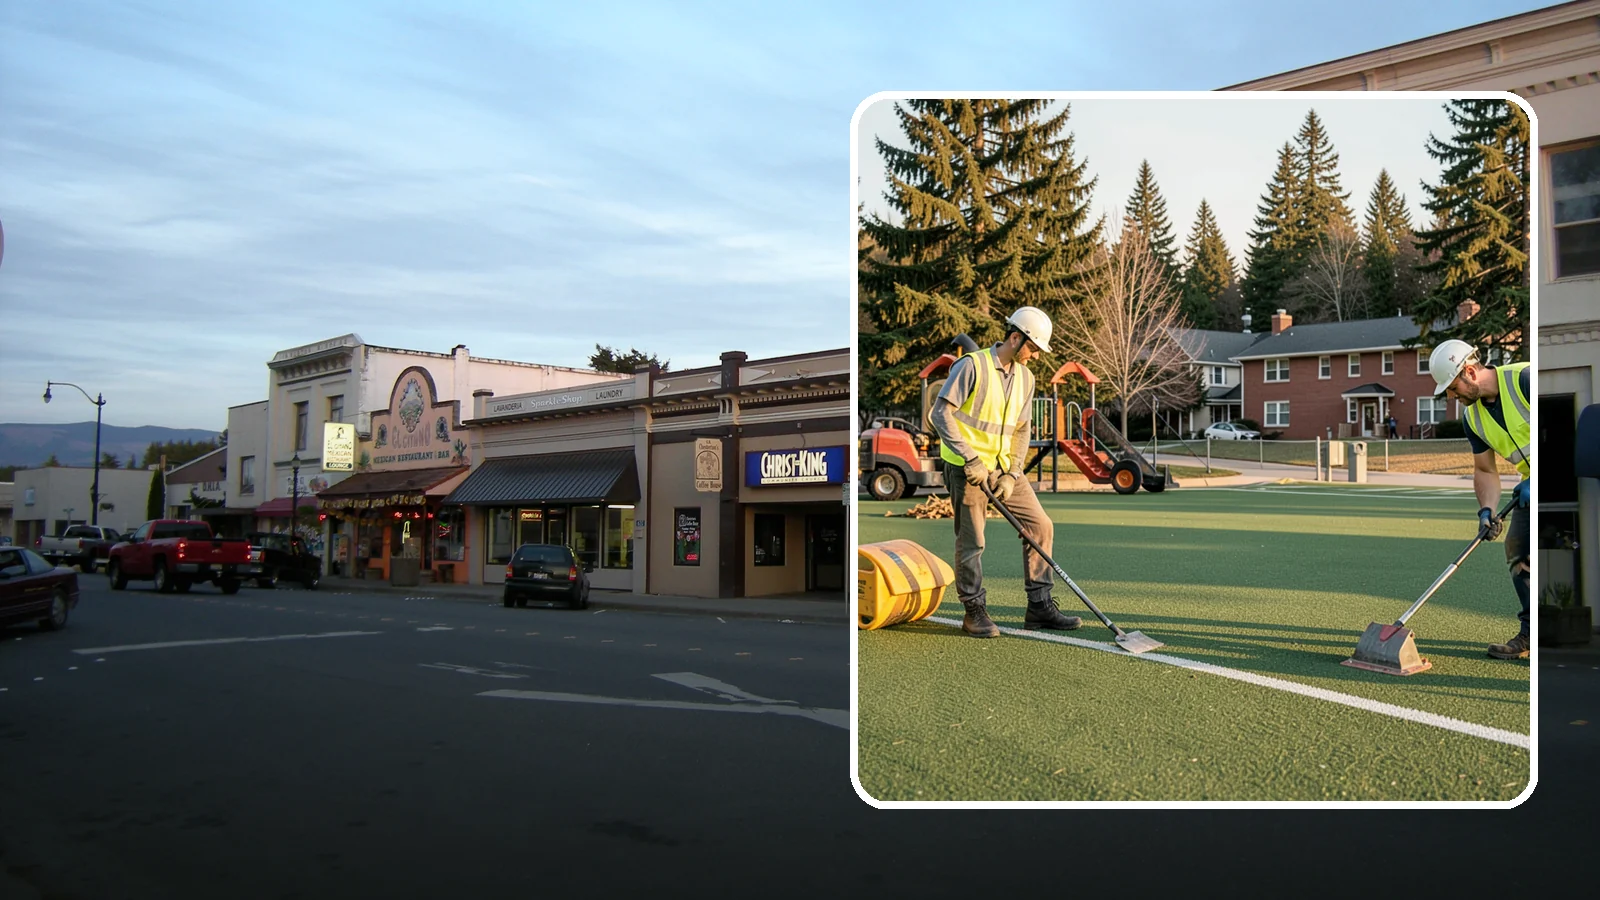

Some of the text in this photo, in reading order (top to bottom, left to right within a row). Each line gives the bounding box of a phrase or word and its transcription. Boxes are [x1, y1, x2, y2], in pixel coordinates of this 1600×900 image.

[595, 389, 623, 399] LAUNDRY
[493, 402, 522, 412] LAVANDERIA
[530, 394, 582, 408] Sparkle Shop
[374, 455, 396, 464] MEXICAN
[397, 451, 433, 462] RESTAURANT
[438, 450, 450, 459] BAR
[760, 450, 827, 478] CHRIST KING
[696, 480, 722, 489] Coffee House
